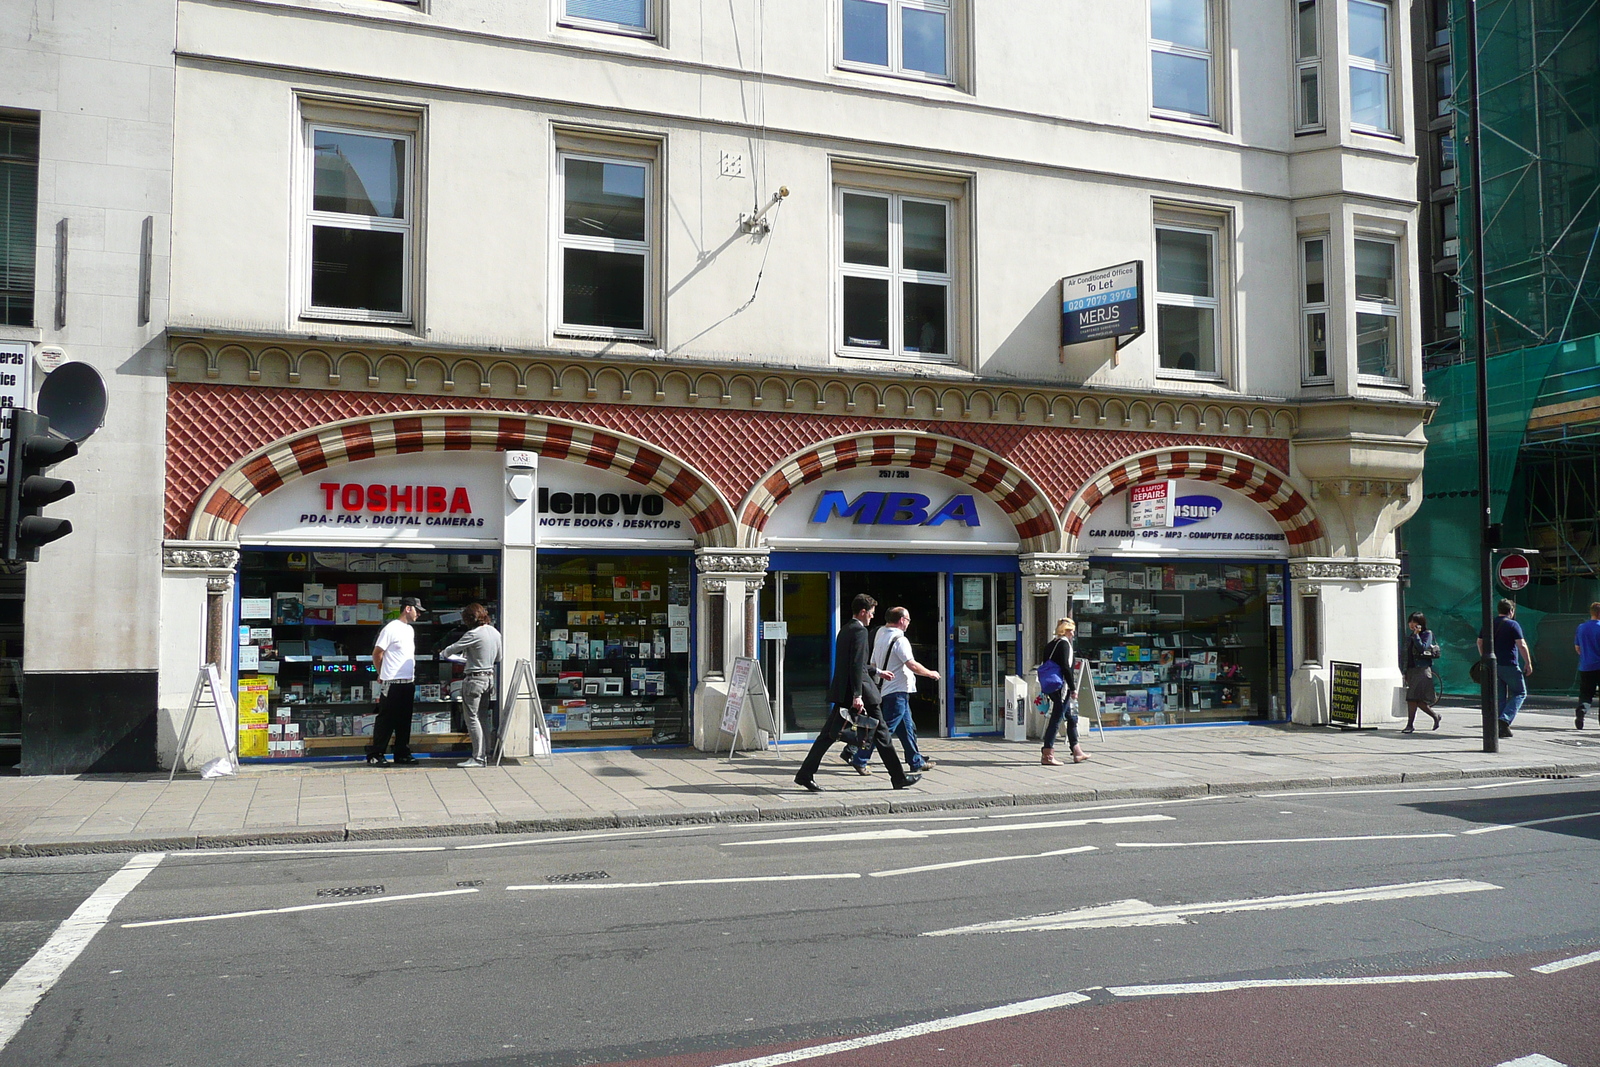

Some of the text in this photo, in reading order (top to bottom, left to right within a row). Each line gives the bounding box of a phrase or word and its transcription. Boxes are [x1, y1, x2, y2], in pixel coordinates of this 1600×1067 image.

[1068, 267, 1133, 287] Air Conditioned Offices
[1087, 279, 1113, 292] To Let
[1068, 290, 1131, 311] 020 7079 3976
[1079, 305, 1120, 325] MERJS
[1133, 490, 1165, 501] REPAIRS
[1145, 483, 1164, 492] LAPTOP
[319, 482, 472, 514] TOSHIBA
[538, 487, 664, 516] lenovo
[810, 489, 981, 527] MBA
[336, 514, 362, 524] FAX
[372, 515, 421, 525] DIGITAL
[425, 516, 485, 527] CAMERAS
[539, 518, 681, 529] NOTE BOOKS DESKTOPS
[1089, 529, 1107, 537] CAR
[1108, 529, 1135, 538] AUDIO
[1165, 531, 1182, 539] MP3
[1189, 531, 1233, 540] COMPUTER
[1234, 532, 1286, 541] ACCESSORIES
